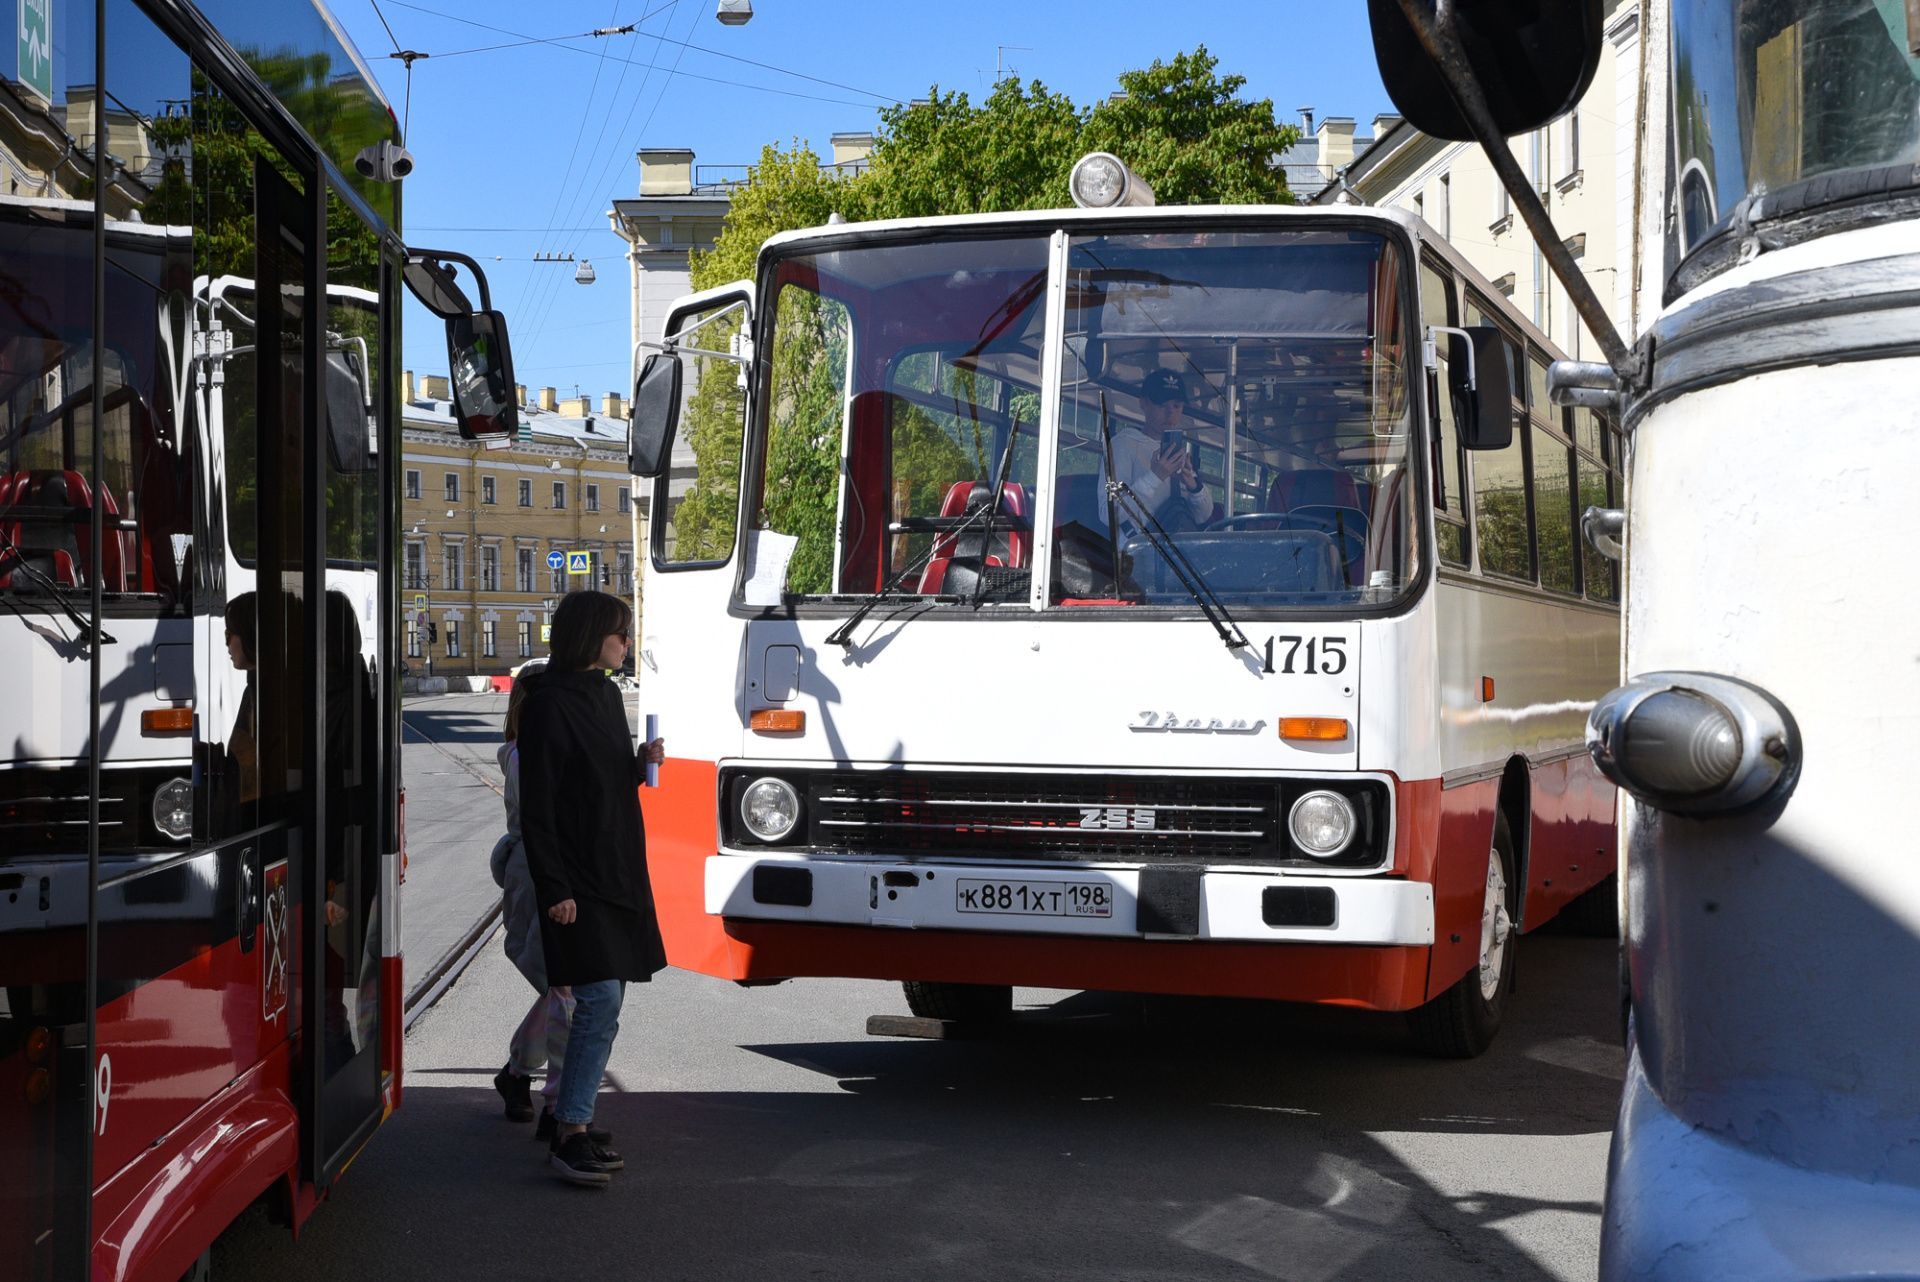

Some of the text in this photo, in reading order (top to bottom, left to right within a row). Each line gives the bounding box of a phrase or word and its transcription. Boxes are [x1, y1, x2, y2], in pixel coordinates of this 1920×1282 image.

[1262, 635, 1347, 675] 1715
[1128, 710, 1267, 735] Ikarus
[965, 884, 1062, 911] К881ХТ
[1068, 886, 1105, 906] 198
[1076, 906, 1095, 914] RUS
[93, 1052, 111, 1136] 9
